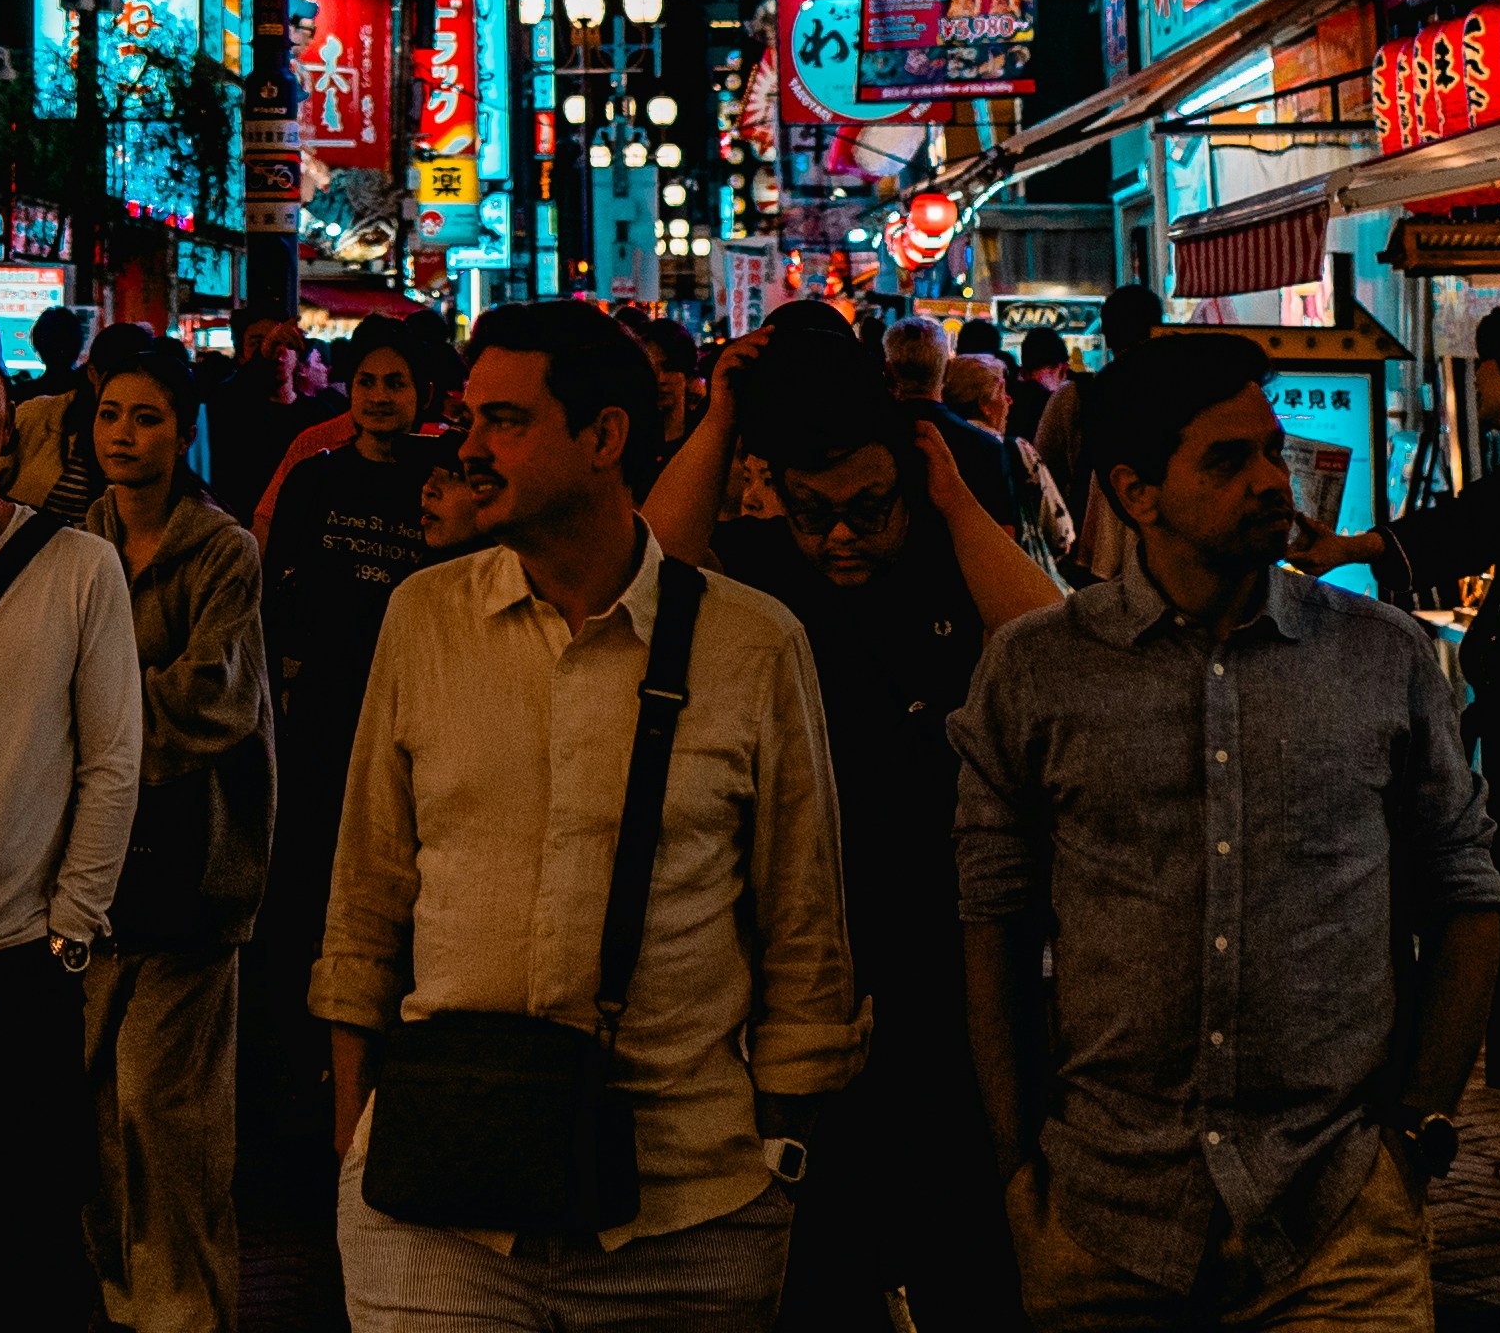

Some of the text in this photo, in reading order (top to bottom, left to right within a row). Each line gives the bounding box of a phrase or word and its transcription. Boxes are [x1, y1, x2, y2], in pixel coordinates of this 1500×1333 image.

[1007, 306, 1061, 327] NMN
[326, 509, 367, 532] Acne
[352, 564, 393, 587] 1996
